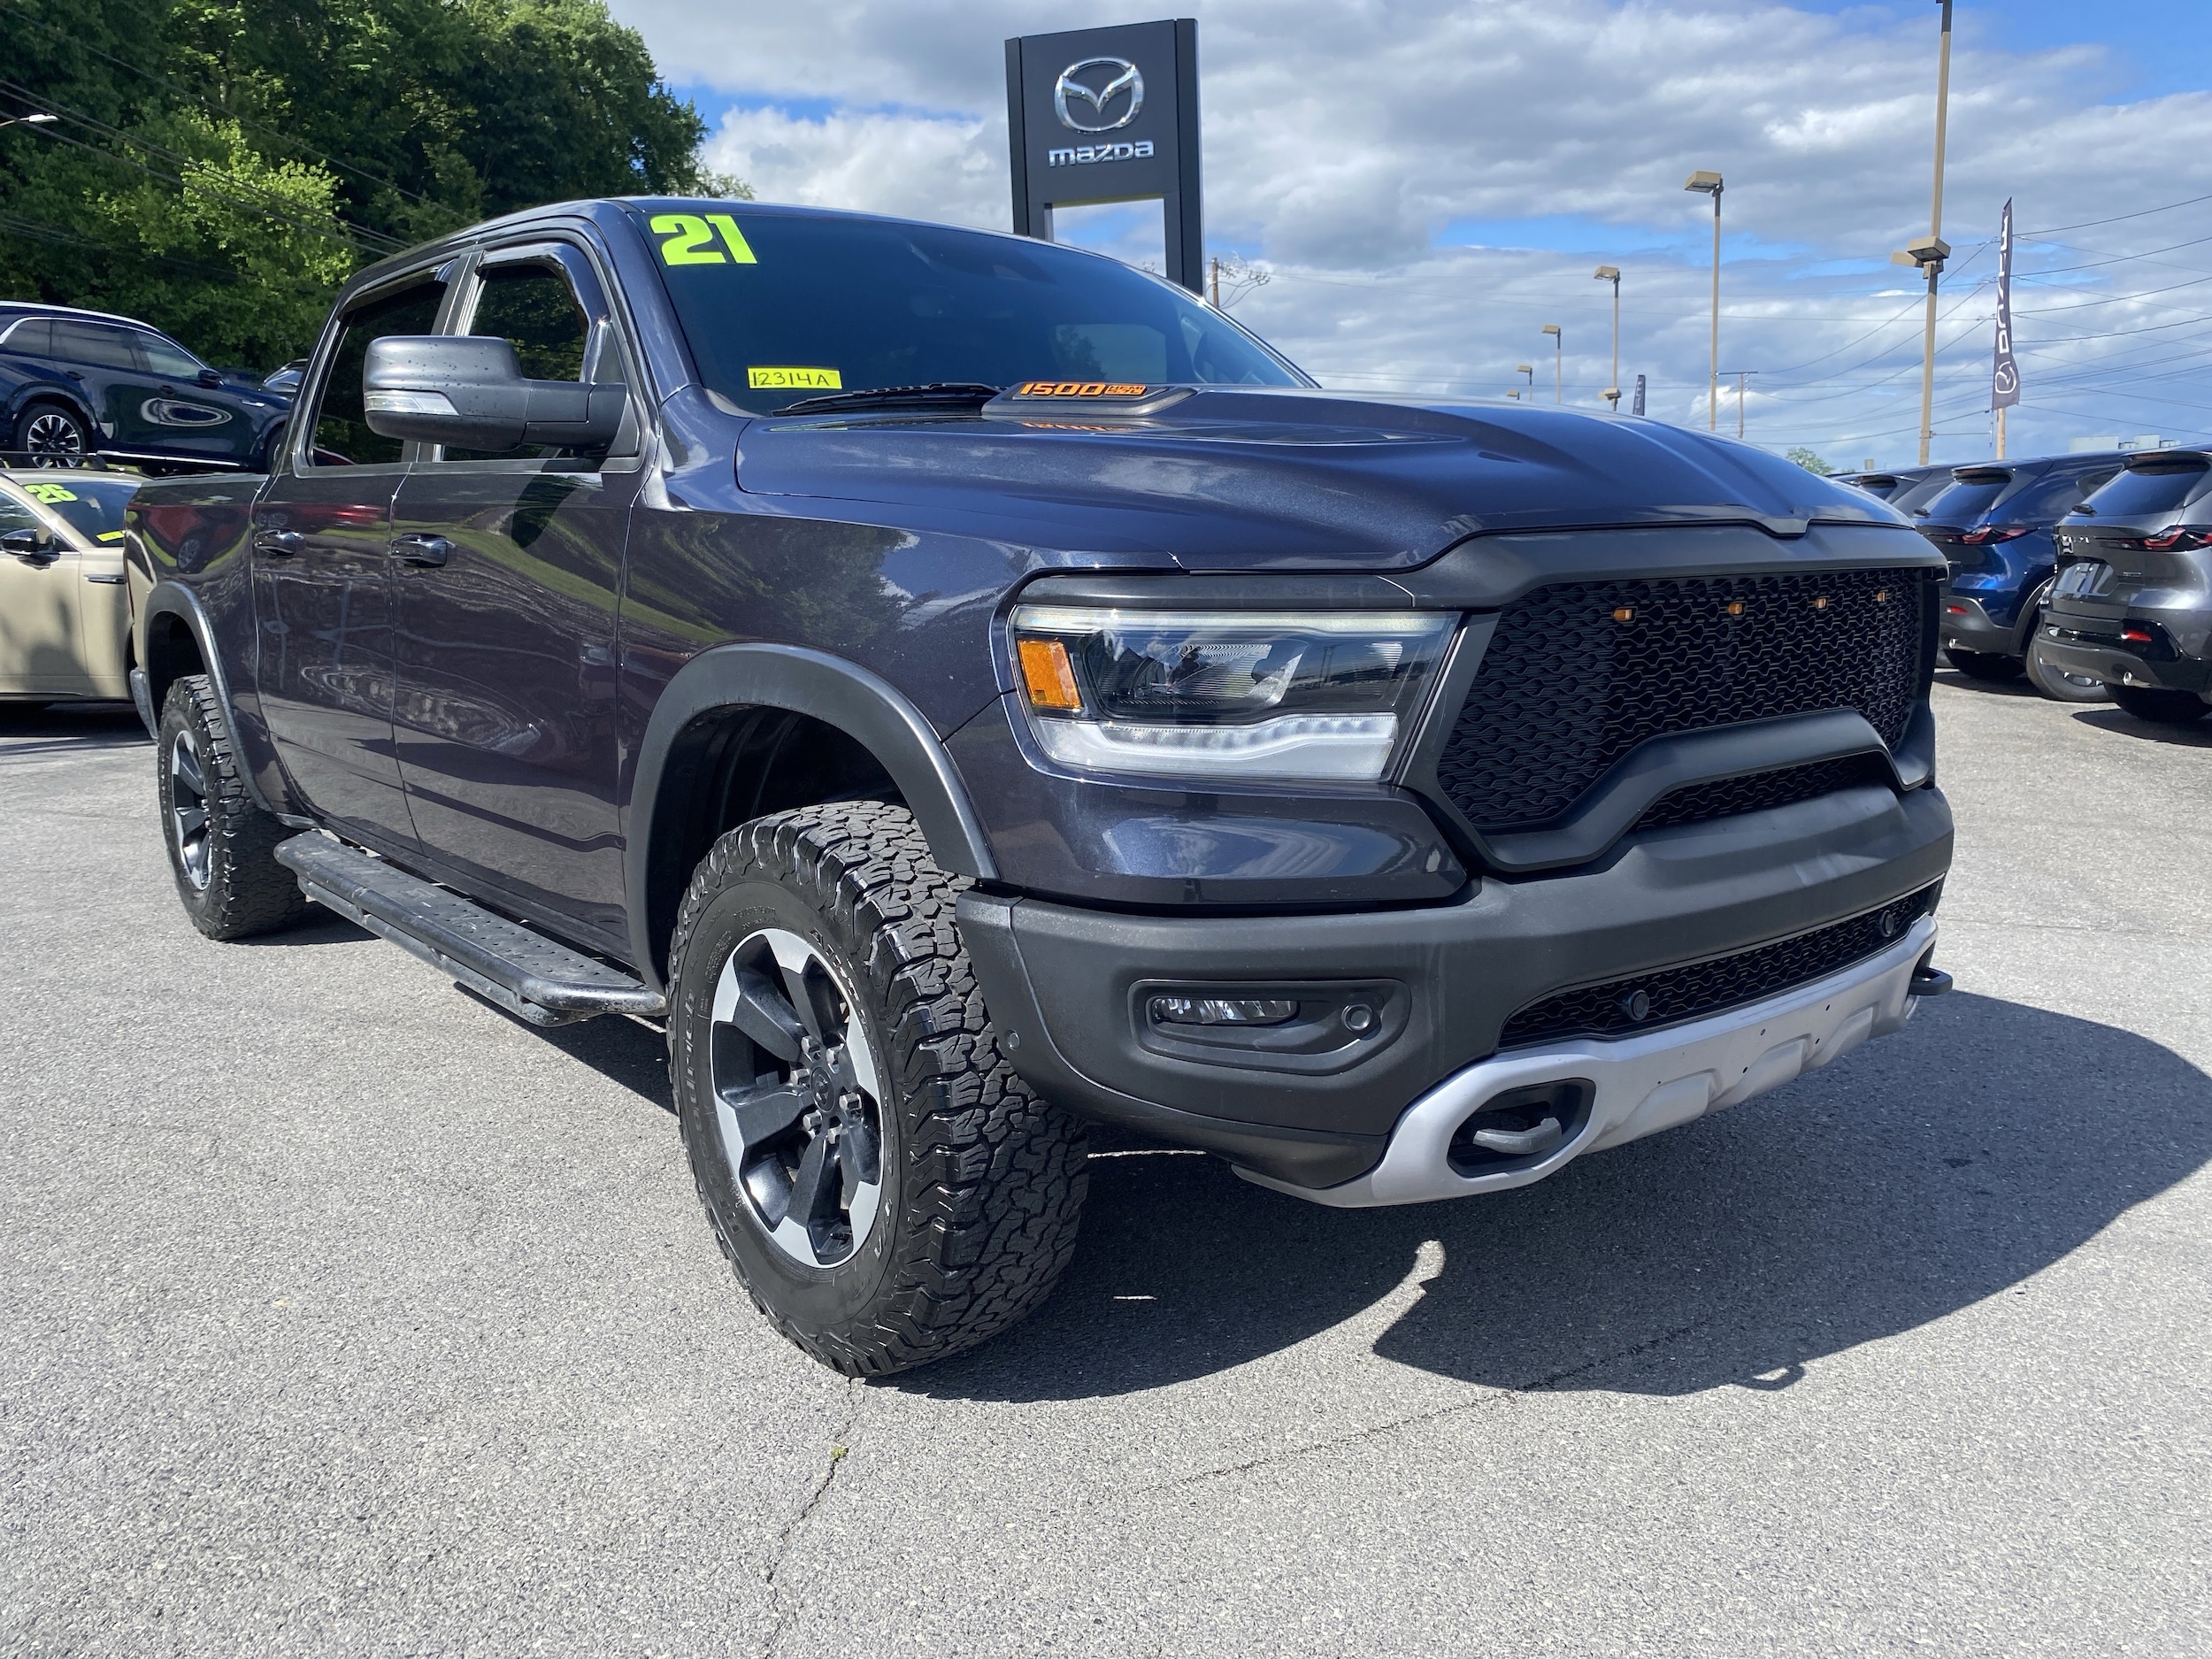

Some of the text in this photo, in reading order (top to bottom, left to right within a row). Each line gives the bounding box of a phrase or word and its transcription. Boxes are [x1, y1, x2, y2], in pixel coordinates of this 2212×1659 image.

[649, 214, 758, 265] 21
[752, 372, 830, 387] 12314A
[1020, 382, 1106, 396] 1500
[24, 483, 79, 504] 26
